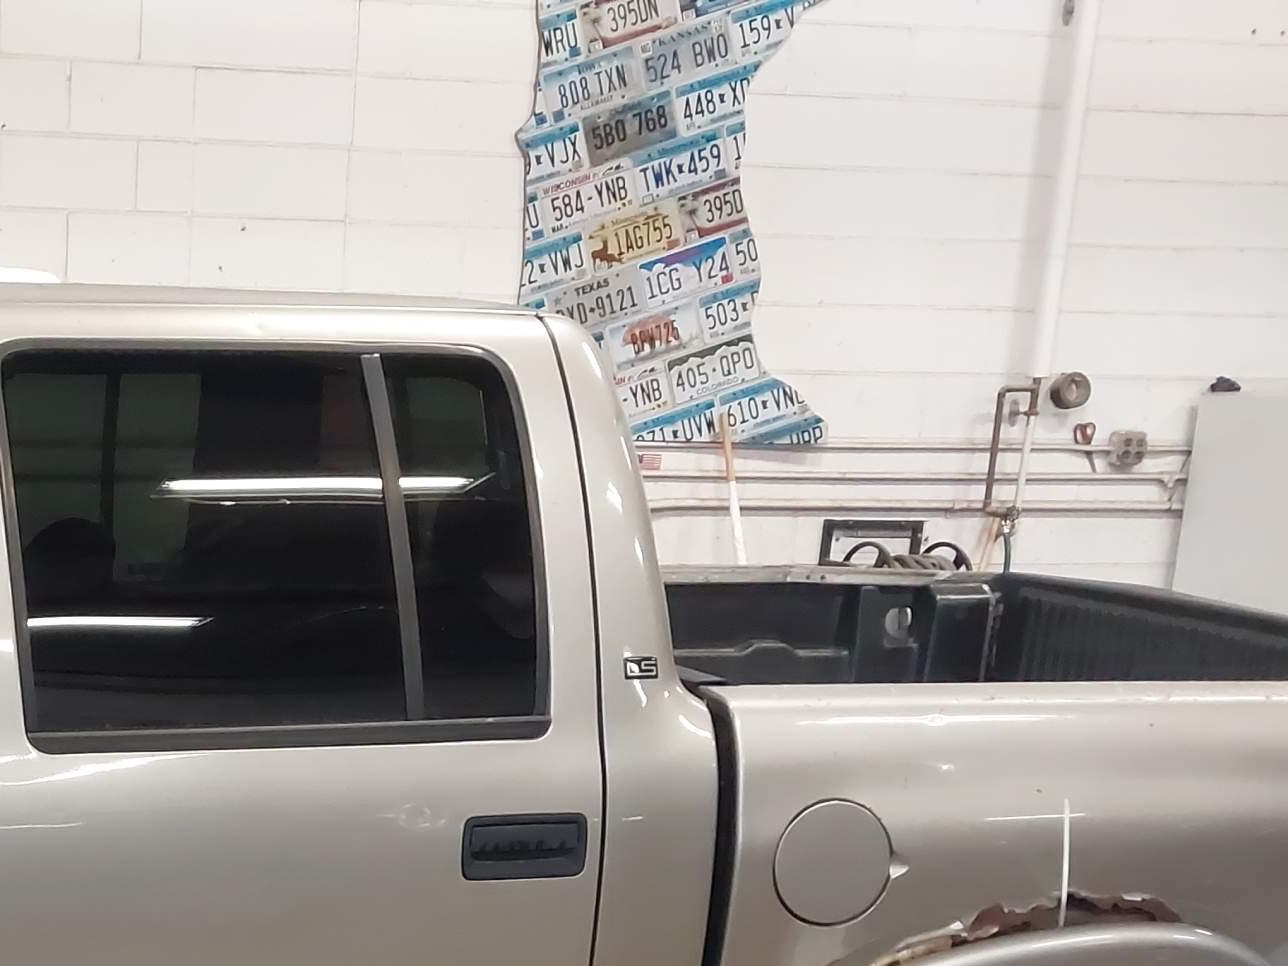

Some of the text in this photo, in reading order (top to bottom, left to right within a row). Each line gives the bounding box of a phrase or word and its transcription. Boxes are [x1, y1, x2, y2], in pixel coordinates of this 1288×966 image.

[542, 22, 579, 57] WRU
[739, 15, 772, 49] 159
[644, 49, 682, 84] 524
[558, 63, 629, 109] 808 TXN
[632, 105, 668, 136] 768
[683, 90, 717, 121] 448
[544, 134, 582, 168] VJX
[640, 143, 722, 193] TWK 459
[548, 242, 585, 276] VWJ
[574, 277, 610, 297] TEXAS
[704, 299, 740, 331] 503
[727, 396, 760, 428] 610
